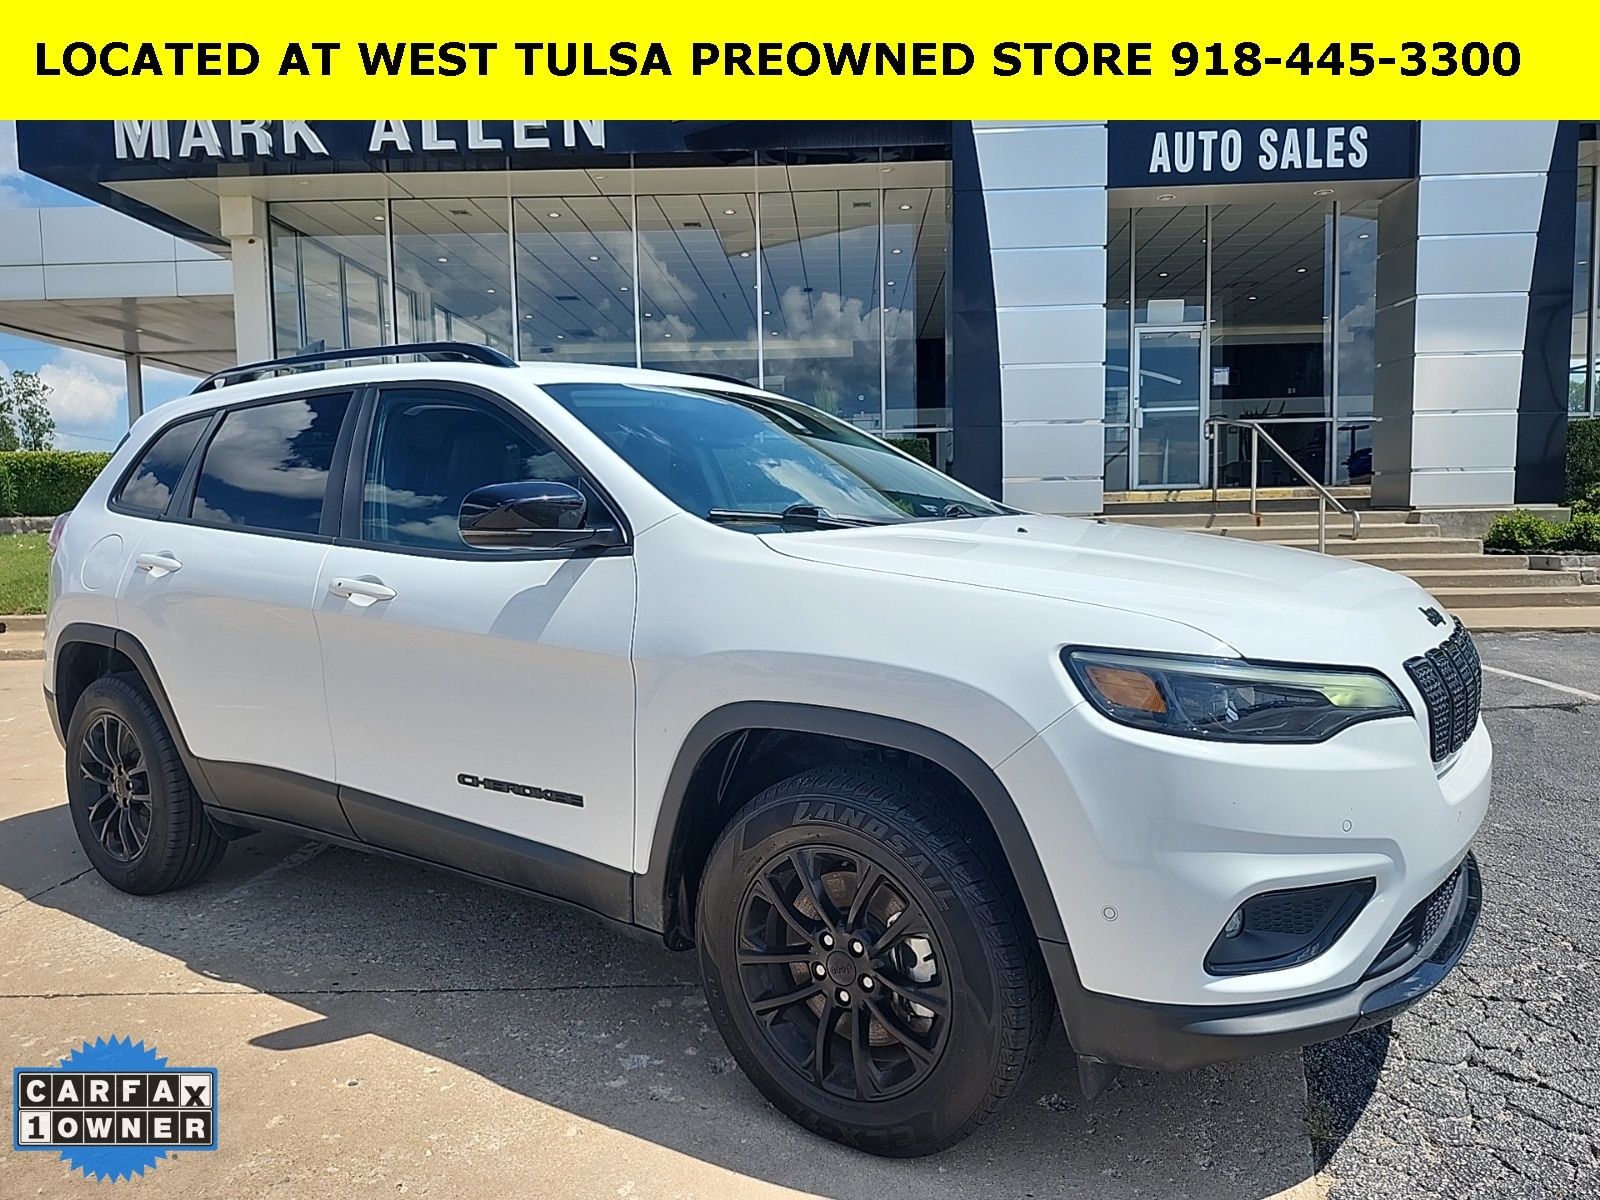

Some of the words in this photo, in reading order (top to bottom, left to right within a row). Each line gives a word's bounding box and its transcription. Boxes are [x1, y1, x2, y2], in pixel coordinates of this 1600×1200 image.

[114, 119, 330, 160] MARK
[1149, 128, 1242, 174] AUTO
[1258, 125, 1369, 171] SALES
[457, 773, 585, 808] CHEROKEE
[792, 801, 957, 911] LANDSAIL
